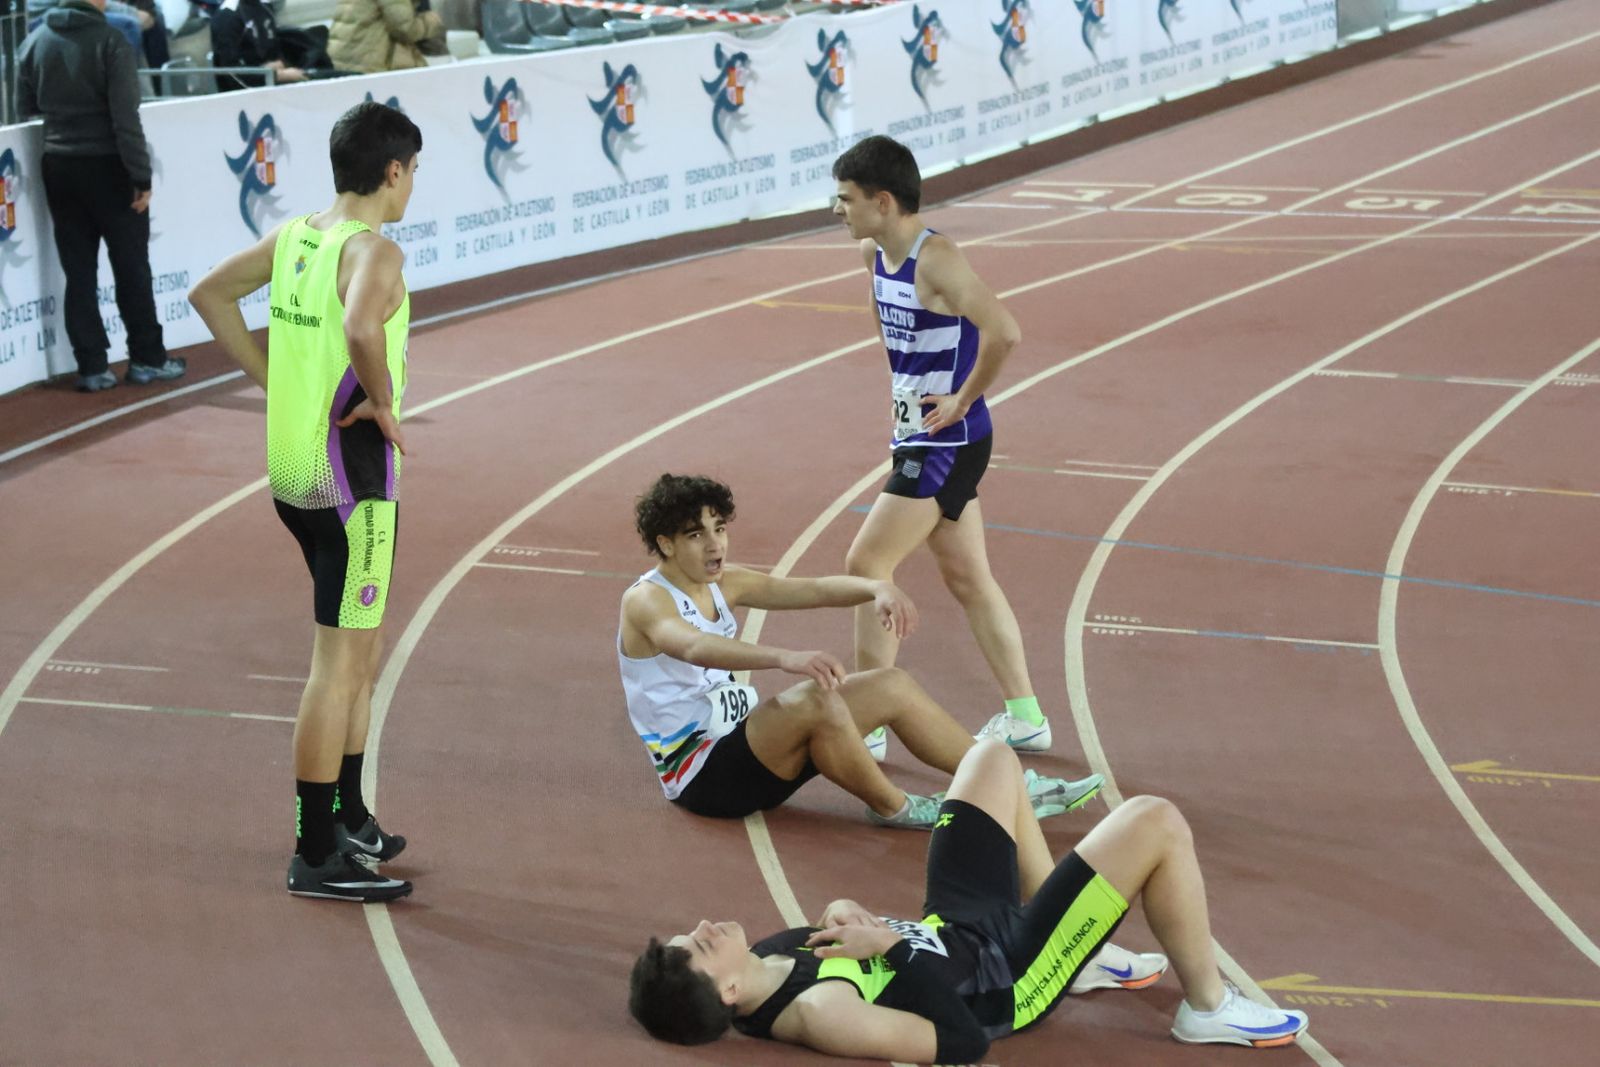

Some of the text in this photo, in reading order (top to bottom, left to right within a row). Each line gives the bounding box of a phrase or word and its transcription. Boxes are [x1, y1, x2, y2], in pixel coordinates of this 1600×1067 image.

[630, 174, 669, 197] ATLETISMO
[686, 193, 697, 210] DE
[702, 184, 739, 206] CASTILLA
[744, 182, 750, 196] Y
[514, 196, 555, 219] ATLETISMO
[573, 196, 670, 234] DE CASTILLA Y LEÓN
[1344, 196, 1444, 211] 5
[456, 219, 556, 259] DE CASTILLA Y LEÓN
[415, 245, 438, 267] LEÓN
[720, 688, 749, 723] 198
[1016, 917, 1098, 1013] PUNTICILLAS PALENCIA
